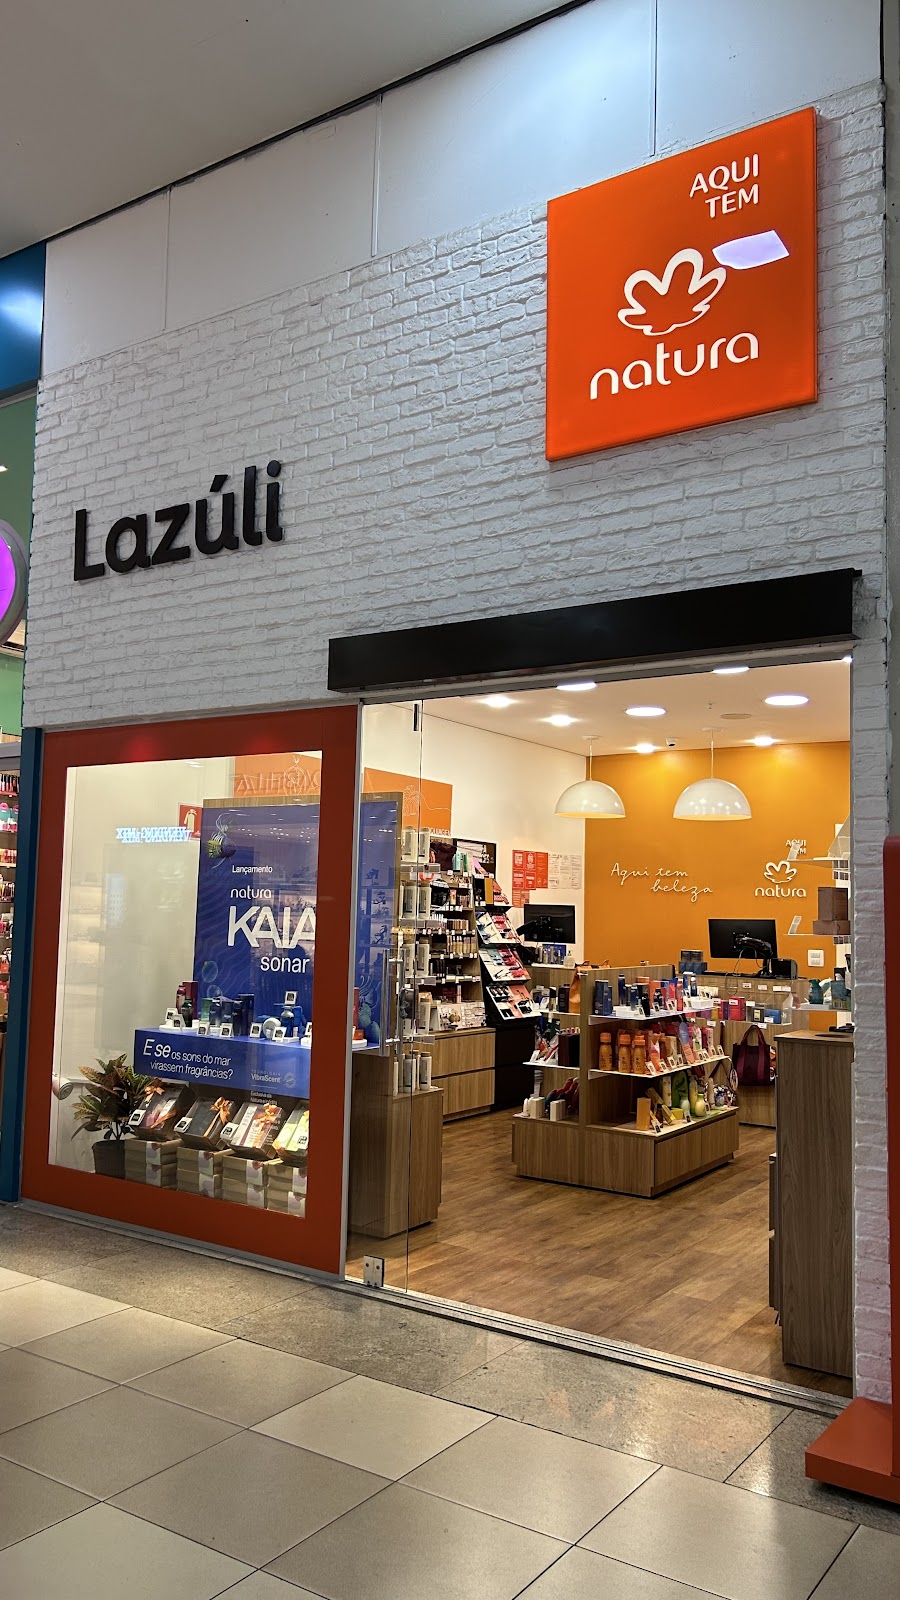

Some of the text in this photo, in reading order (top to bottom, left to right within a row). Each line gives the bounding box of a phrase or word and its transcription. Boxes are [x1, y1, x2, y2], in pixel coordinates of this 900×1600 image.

[690, 153, 760, 198] AQUI
[704, 183, 760, 219] TEM
[590, 332, 760, 400] natura
[73, 460, 283, 581] Lazúli
[232, 865, 273, 875] Lançamento
[610, 862, 688, 885] Aqui tem
[230, 885, 272, 899] natura
[651, 879, 714, 903] beleza
[754, 885, 807, 898] natura
[260, 956, 310, 973] sonar
[143, 1038, 231, 1066] E se os sons do mar
[150, 1061, 234, 1080] virassem fragrâncias?
